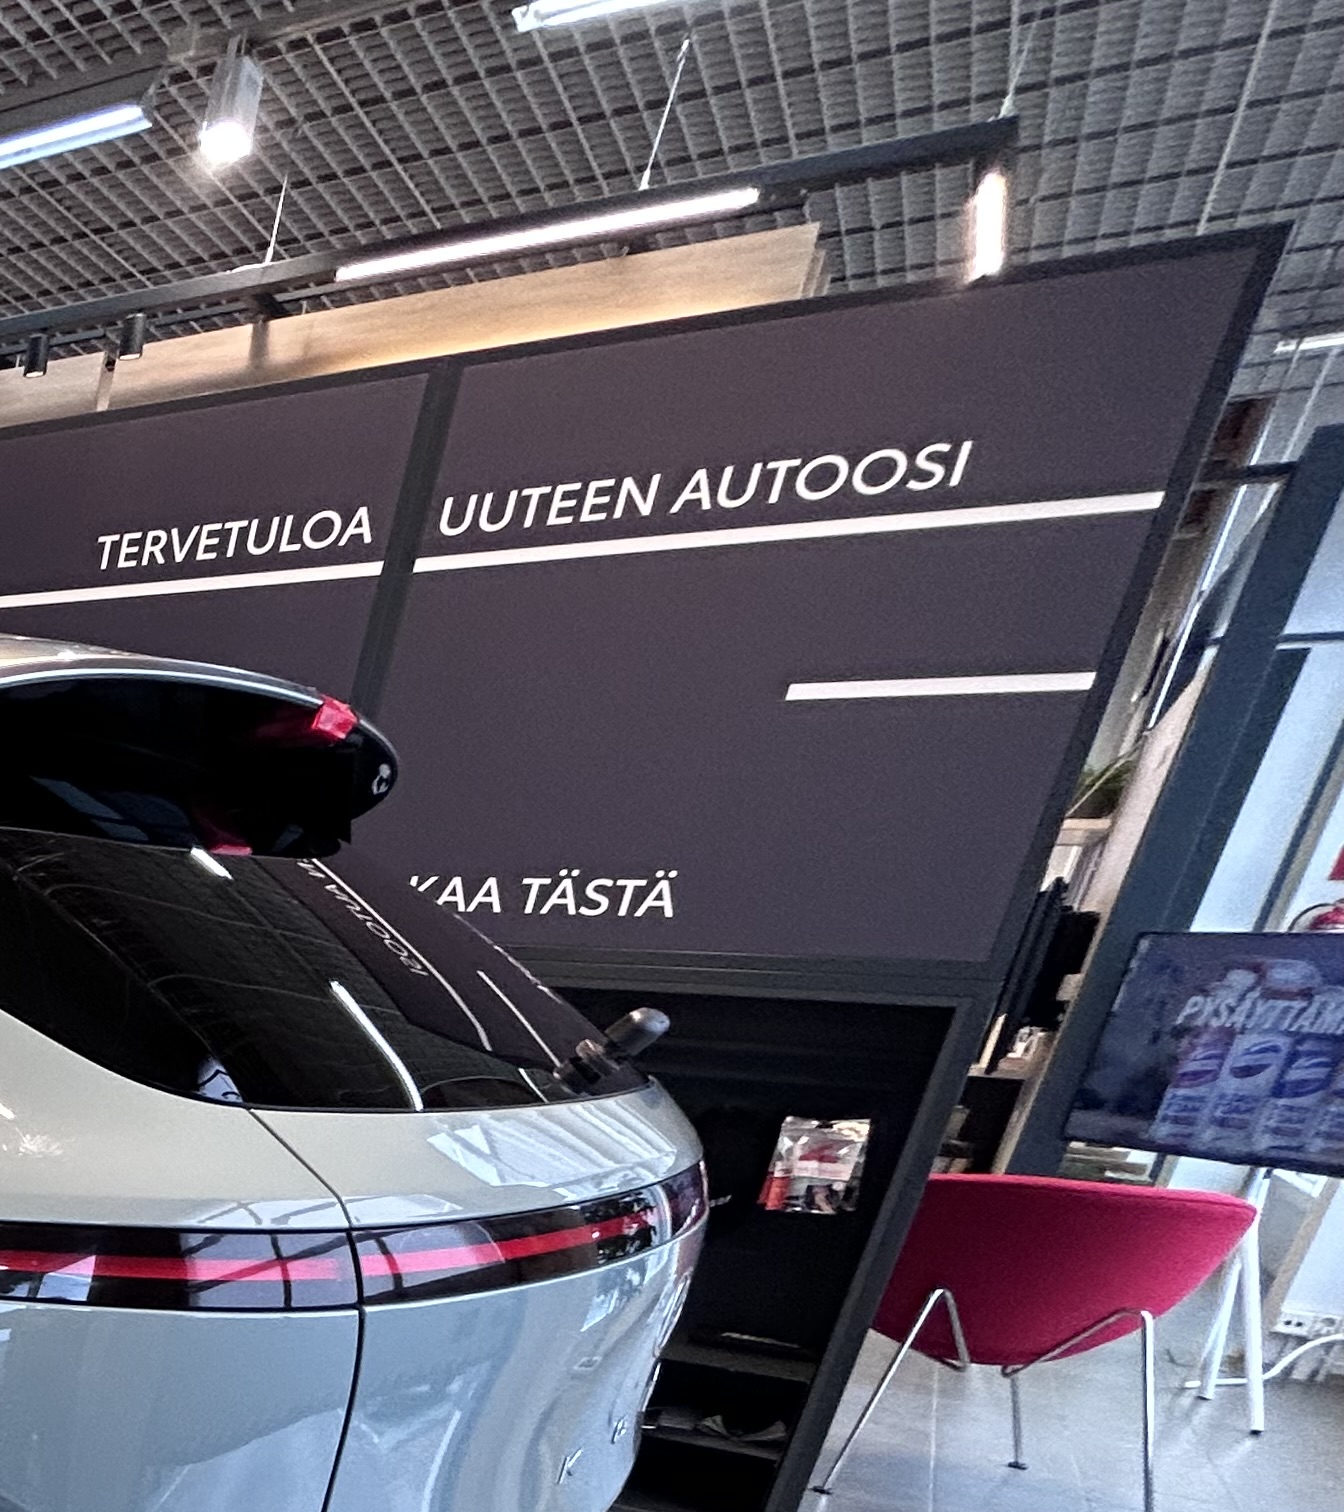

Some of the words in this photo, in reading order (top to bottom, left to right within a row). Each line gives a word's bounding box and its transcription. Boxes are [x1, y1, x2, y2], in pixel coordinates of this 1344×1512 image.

[97, 506, 373, 570] TERVETULOA
[438, 473, 661, 536] UUTEEN
[670, 440, 974, 515] AUTOOSI
[521, 868, 679, 918] TÄSTÄ
